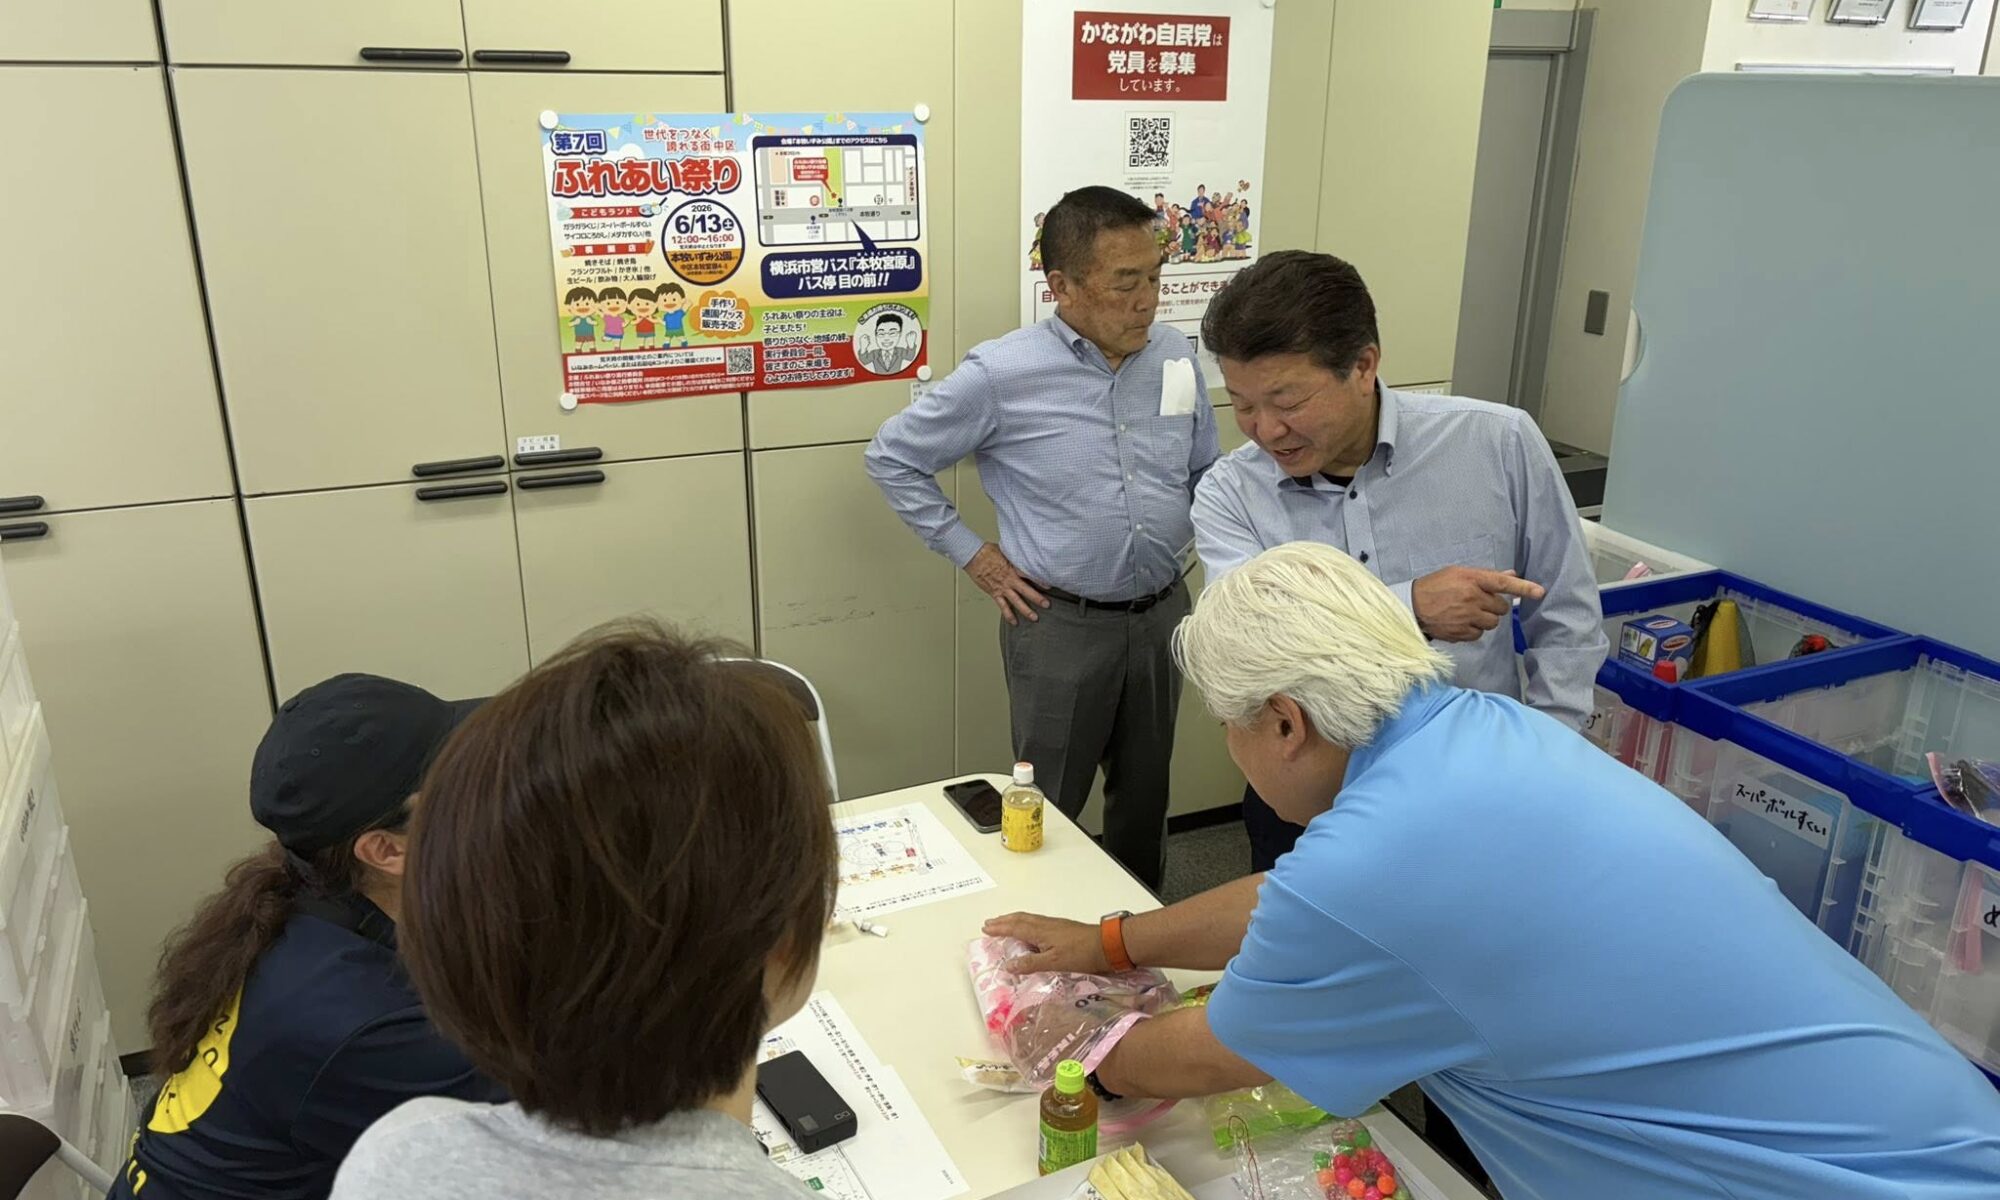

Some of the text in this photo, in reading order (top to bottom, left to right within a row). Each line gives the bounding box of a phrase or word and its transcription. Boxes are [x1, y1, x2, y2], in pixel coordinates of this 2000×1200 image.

[1081, 21, 1223, 47] かながわ自民党は
[1107, 50, 1197, 75] 党員を募集
[1119, 78, 1181, 93] しています。
[554, 133, 602, 151] 第7回
[714, 140, 735, 151] 中区
[555, 158, 739, 194] ふれあい祭り
[581, 207, 633, 217] こどもランド
[691, 204, 712, 213] 2026
[675, 213, 722, 234] 6/13
[710, 298, 736, 309] 手作り
[1735, 783, 1827, 836] スーパーボールすくい
